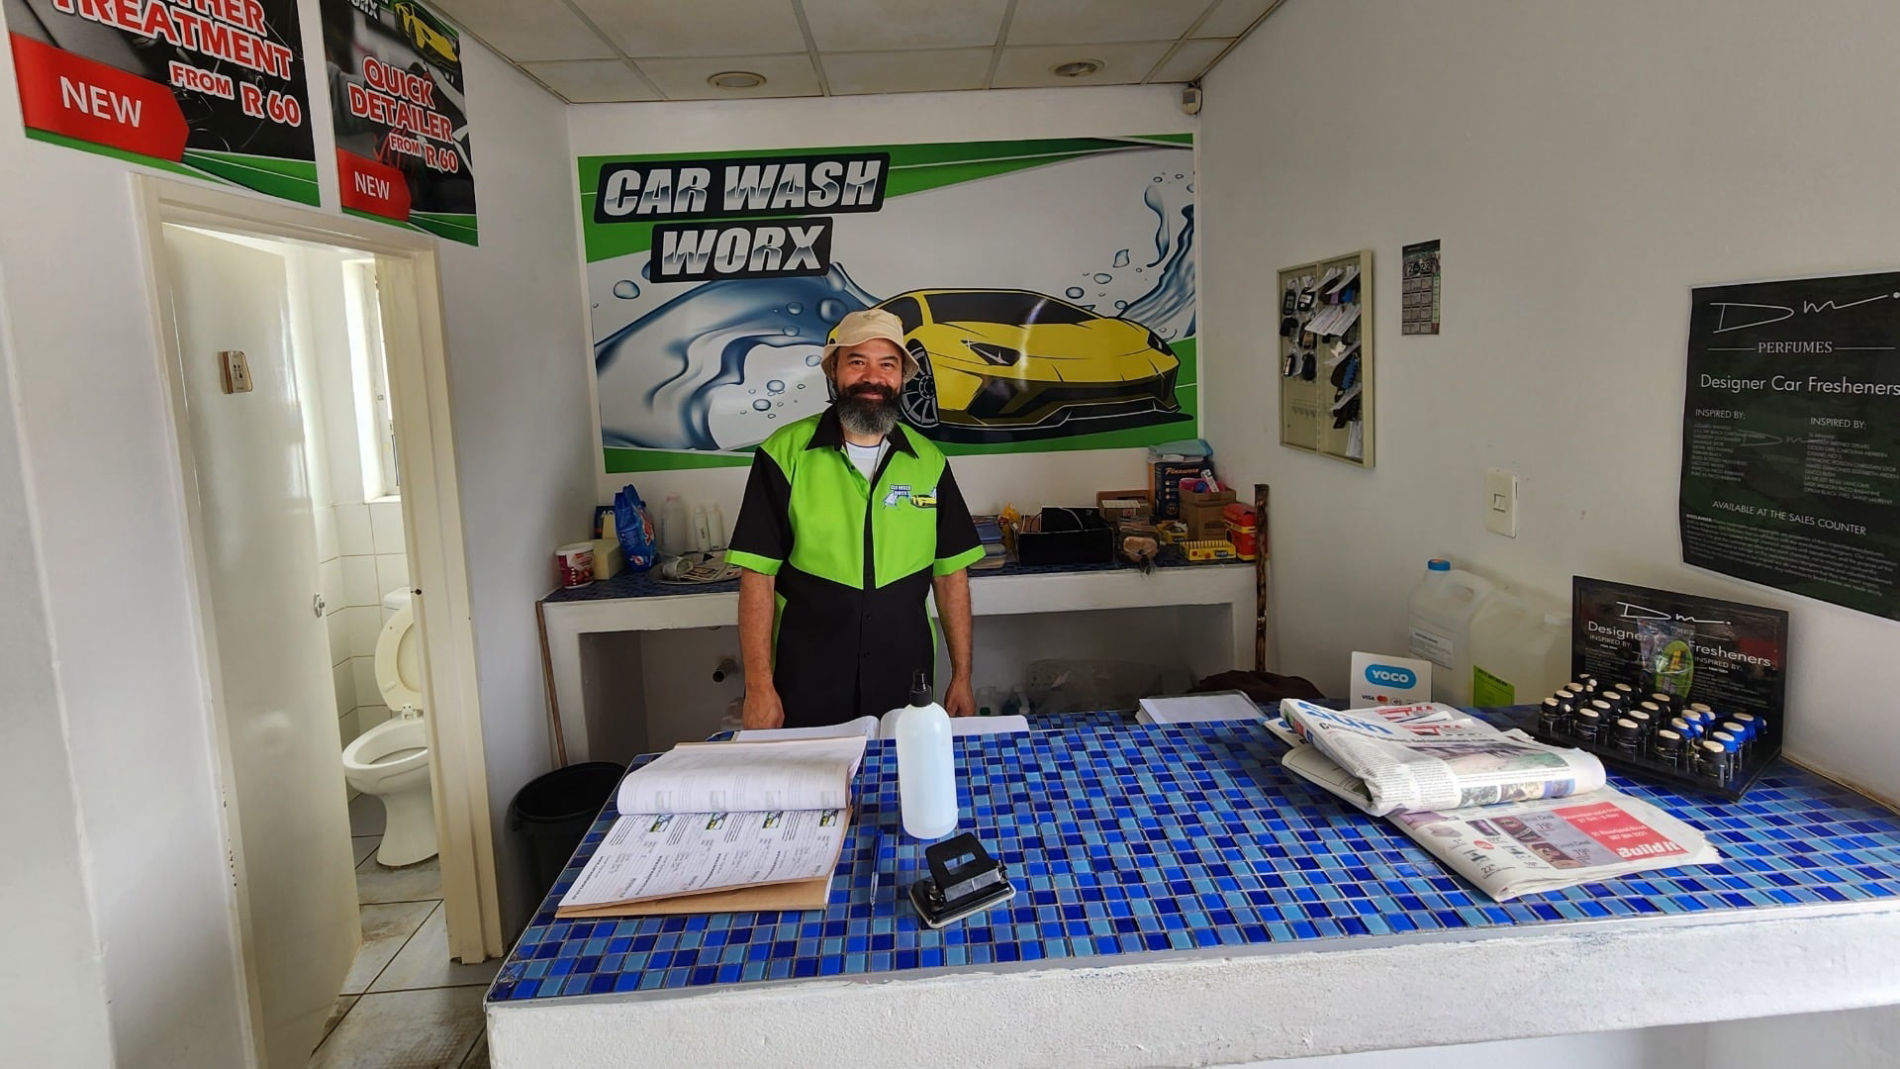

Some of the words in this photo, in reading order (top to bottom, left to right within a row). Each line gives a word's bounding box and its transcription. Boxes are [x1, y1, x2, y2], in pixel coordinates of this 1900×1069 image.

[168, 61, 234, 100] FROM
[363, 56, 435, 109] QUICK
[60, 76, 142, 128] NEW
[348, 83, 453, 143] DETAILER
[389, 133, 421, 157] FROM
[355, 171, 390, 200] NEW
[603, 167, 711, 216] CAR
[723, 160, 881, 211] WASH
[661, 225, 825, 276] WORX
[1758, 341, 1833, 354] PERFUMES
[1700, 374, 1767, 394] Designer
[1771, 375, 1802, 392] Car
[1807, 376, 1900, 396] Fresheners
[1695, 408, 1732, 419] INSPIRED
[1810, 417, 1851, 428] INSPIRED
[1712, 500, 1754, 515] AVAILABLE
[1756, 507, 1769, 517] AT
[1770, 509, 1787, 520] THE
[1789, 513, 1815, 526] SALES
[1817, 518, 1867, 536] COUNTER
[1688, 639, 1772, 667] Fresheners
[1695, 656, 1729, 669] INSPIRED
[1372, 669, 1409, 683] YOCO
[1616, 843, 1664, 858] Build
